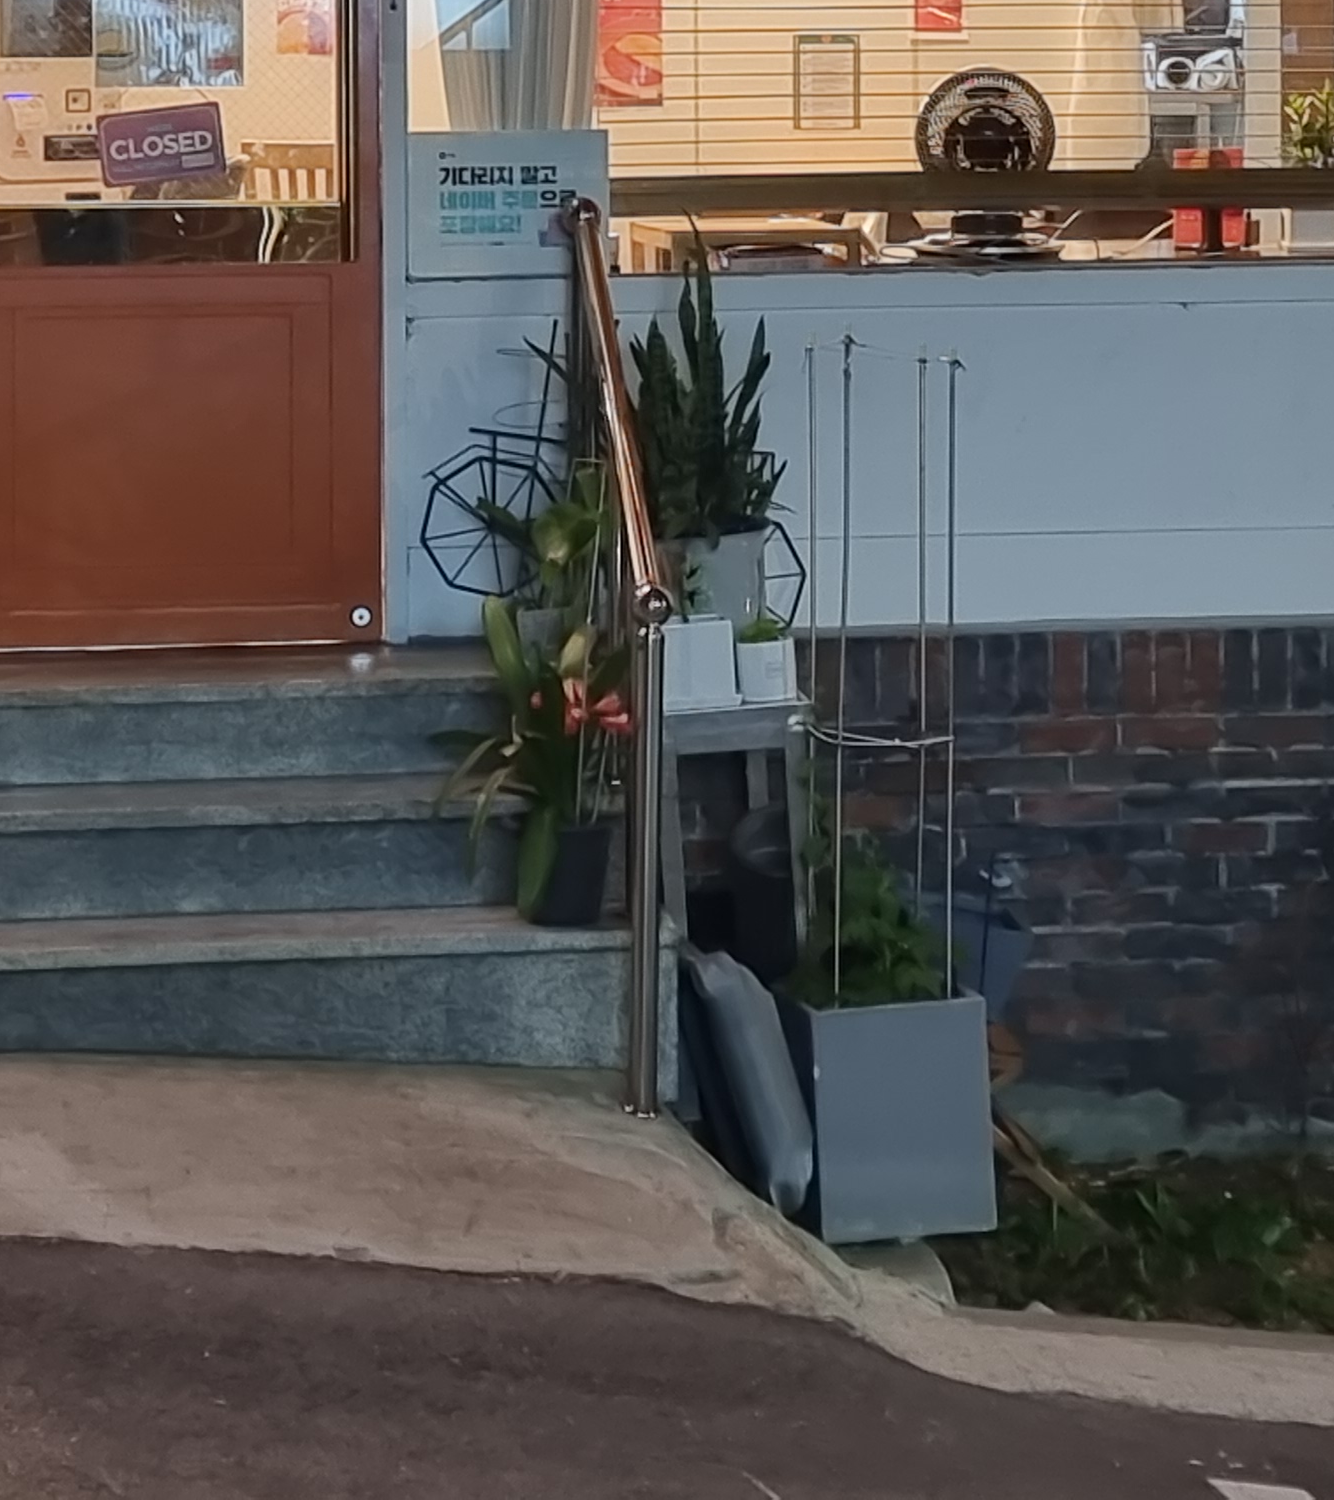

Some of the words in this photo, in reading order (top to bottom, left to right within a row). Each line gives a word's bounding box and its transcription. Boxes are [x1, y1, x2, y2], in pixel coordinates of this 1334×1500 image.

[108, 130, 214, 162] CLOSED
[438, 165, 513, 186] 기다리지
[520, 165, 558, 185] 말고
[439, 190, 496, 211] 네이버
